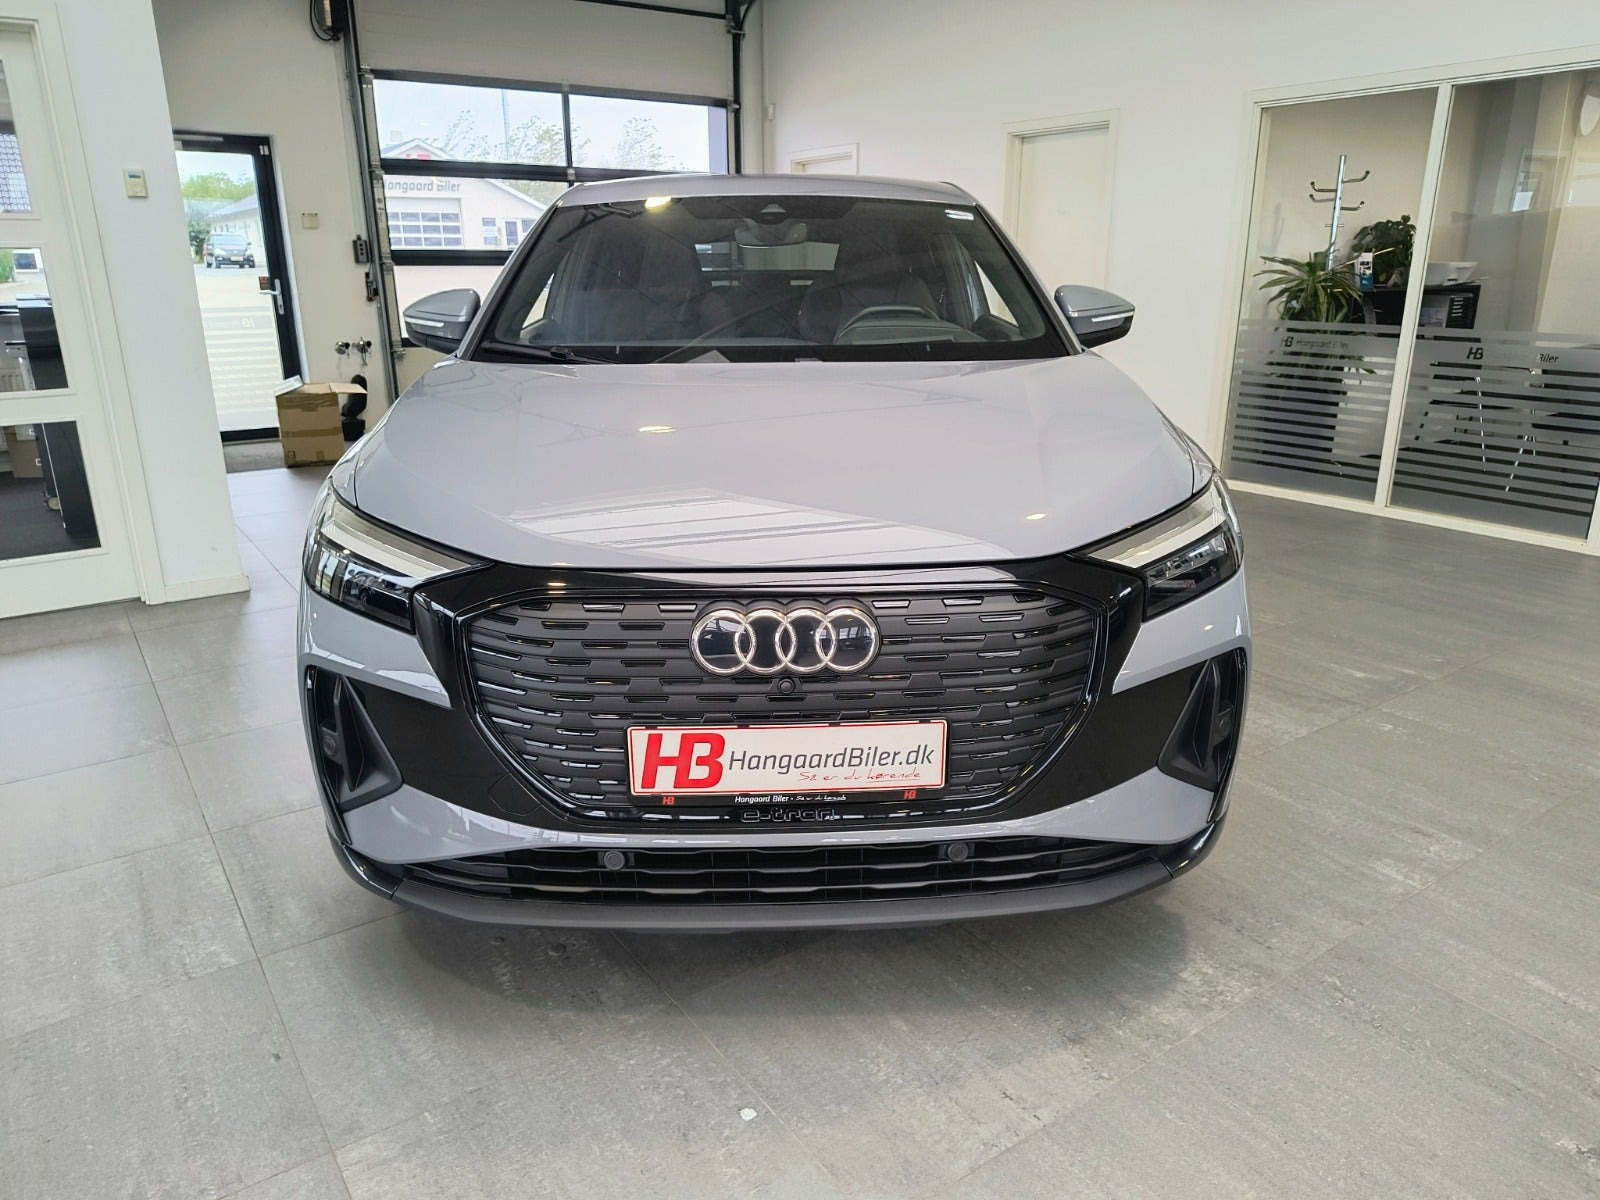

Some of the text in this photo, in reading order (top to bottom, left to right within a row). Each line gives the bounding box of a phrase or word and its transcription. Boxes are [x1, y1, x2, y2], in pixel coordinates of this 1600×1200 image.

[384, 180, 434, 193] angaard
[1466, 347, 1484, 360] HB
[641, 733, 936, 789] HB HangaardBiler.dk
[662, 796, 675, 805] HB
[735, 795, 771, 804] Hangaard
[772, 794, 789, 803] Biler
[904, 790, 917, 800] HB
[741, 807, 836, 822] e-tron
